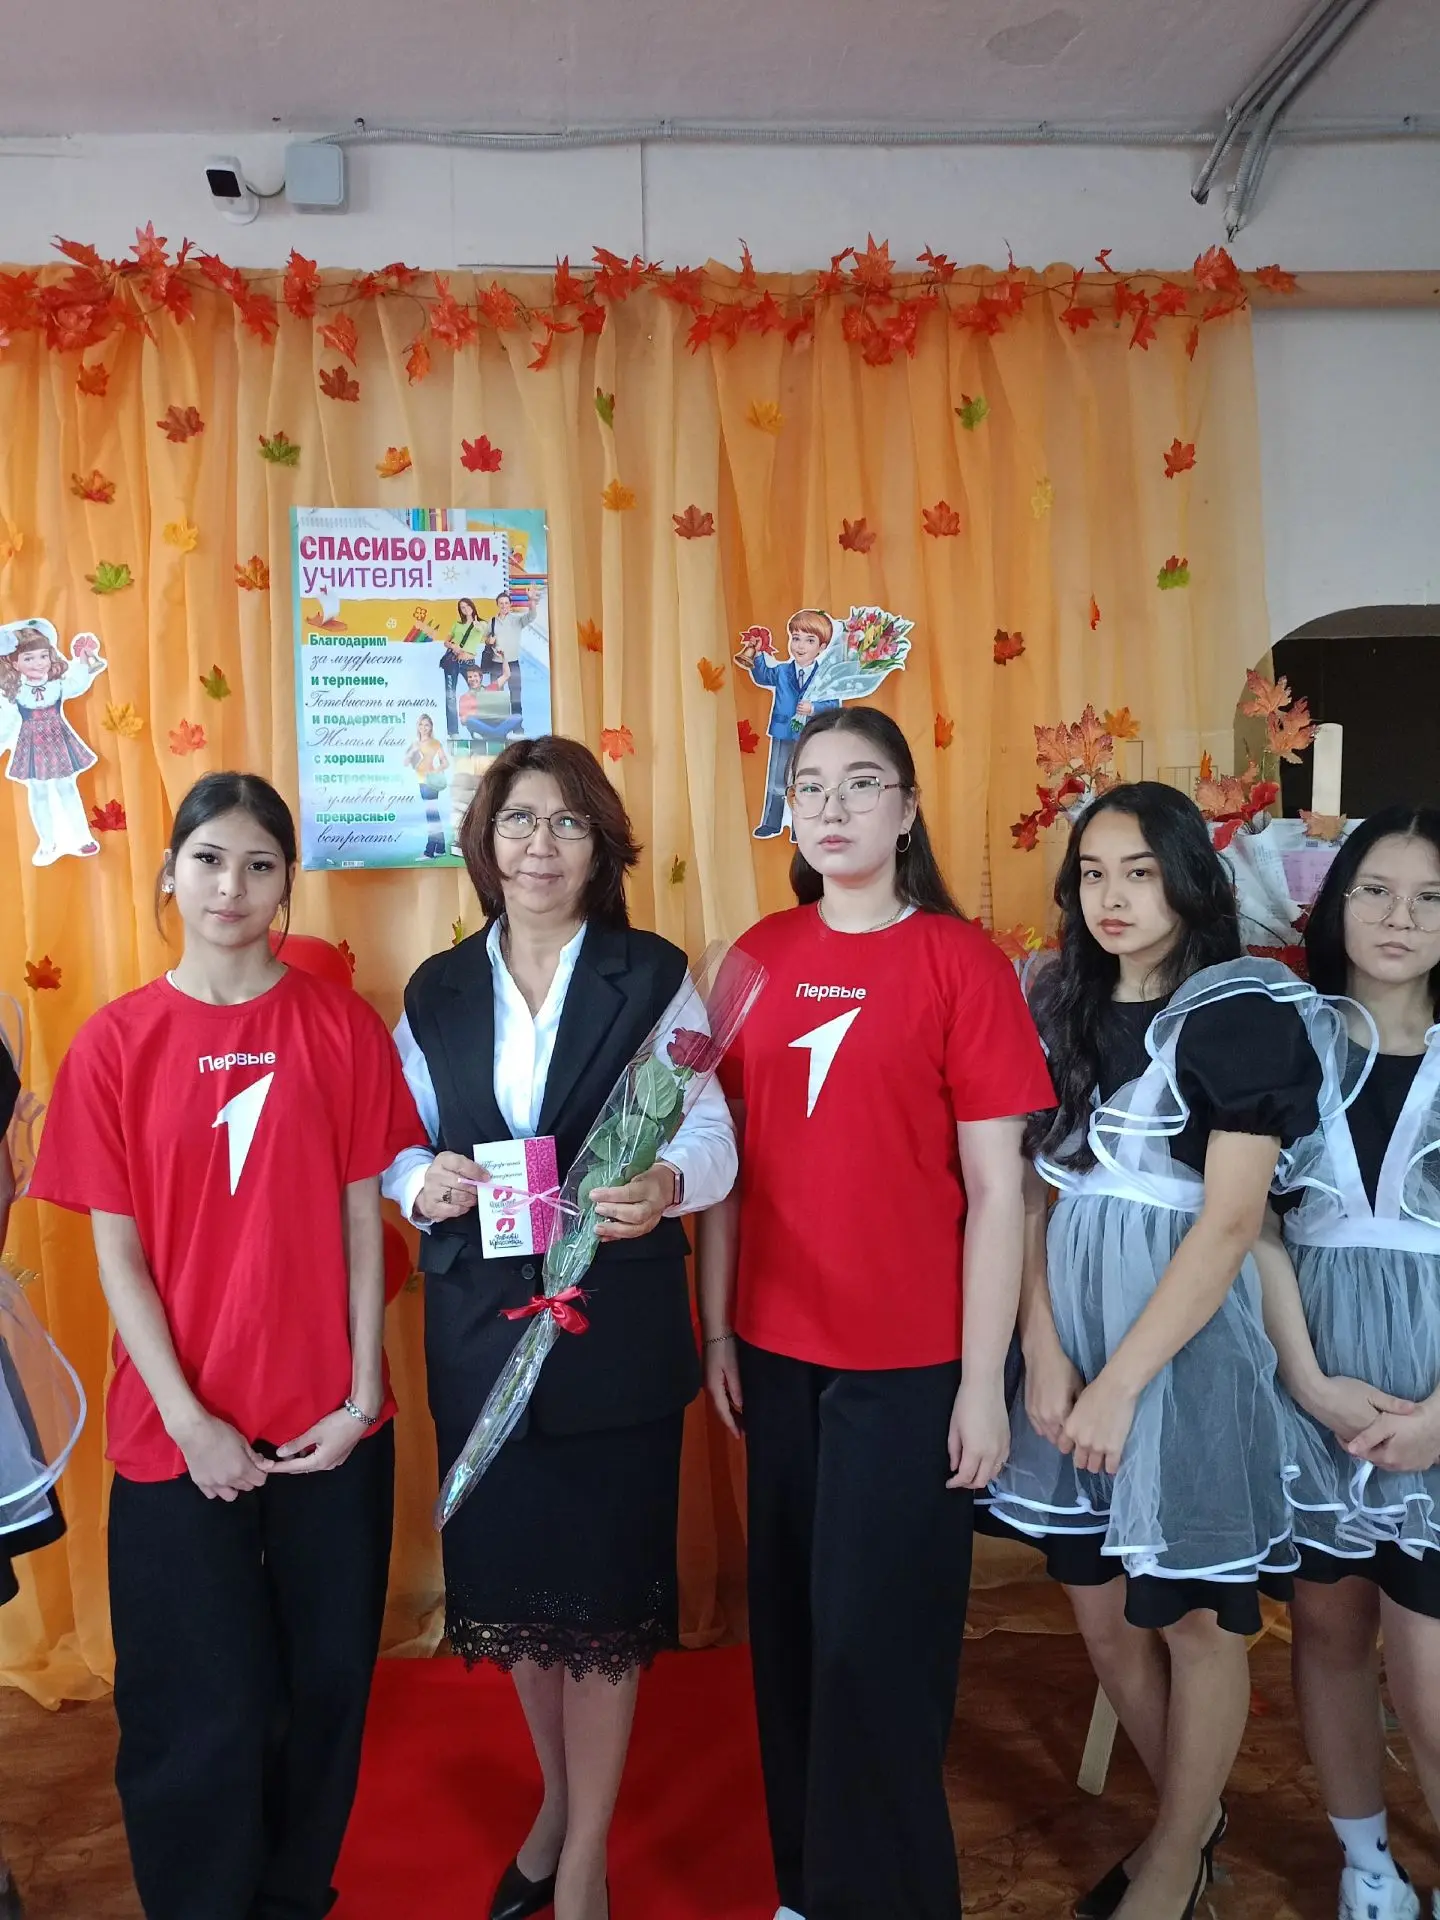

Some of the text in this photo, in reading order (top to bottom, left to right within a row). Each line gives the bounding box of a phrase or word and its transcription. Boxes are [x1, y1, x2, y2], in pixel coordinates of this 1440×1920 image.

[300, 535, 499, 567] СПАСИБО ВАМ,
[303, 559, 433, 593] учителя!
[310, 634, 387, 648] Благодарим
[310, 652, 404, 672] за мудрость
[311, 676, 388, 688] и терпение,
[305, 688, 383, 708] Готовность
[385, 699, 395, 708] и
[312, 712, 406, 726] и поддержать!
[306, 727, 375, 746] Желаем
[324, 754, 385, 766] хорошим
[384, 795, 416, 811] дни
[316, 812, 396, 824] прекрасные
[317, 825, 404, 850] встречать!
[796, 982, 867, 1002] Первые
[198, 1051, 276, 1073] Первые
